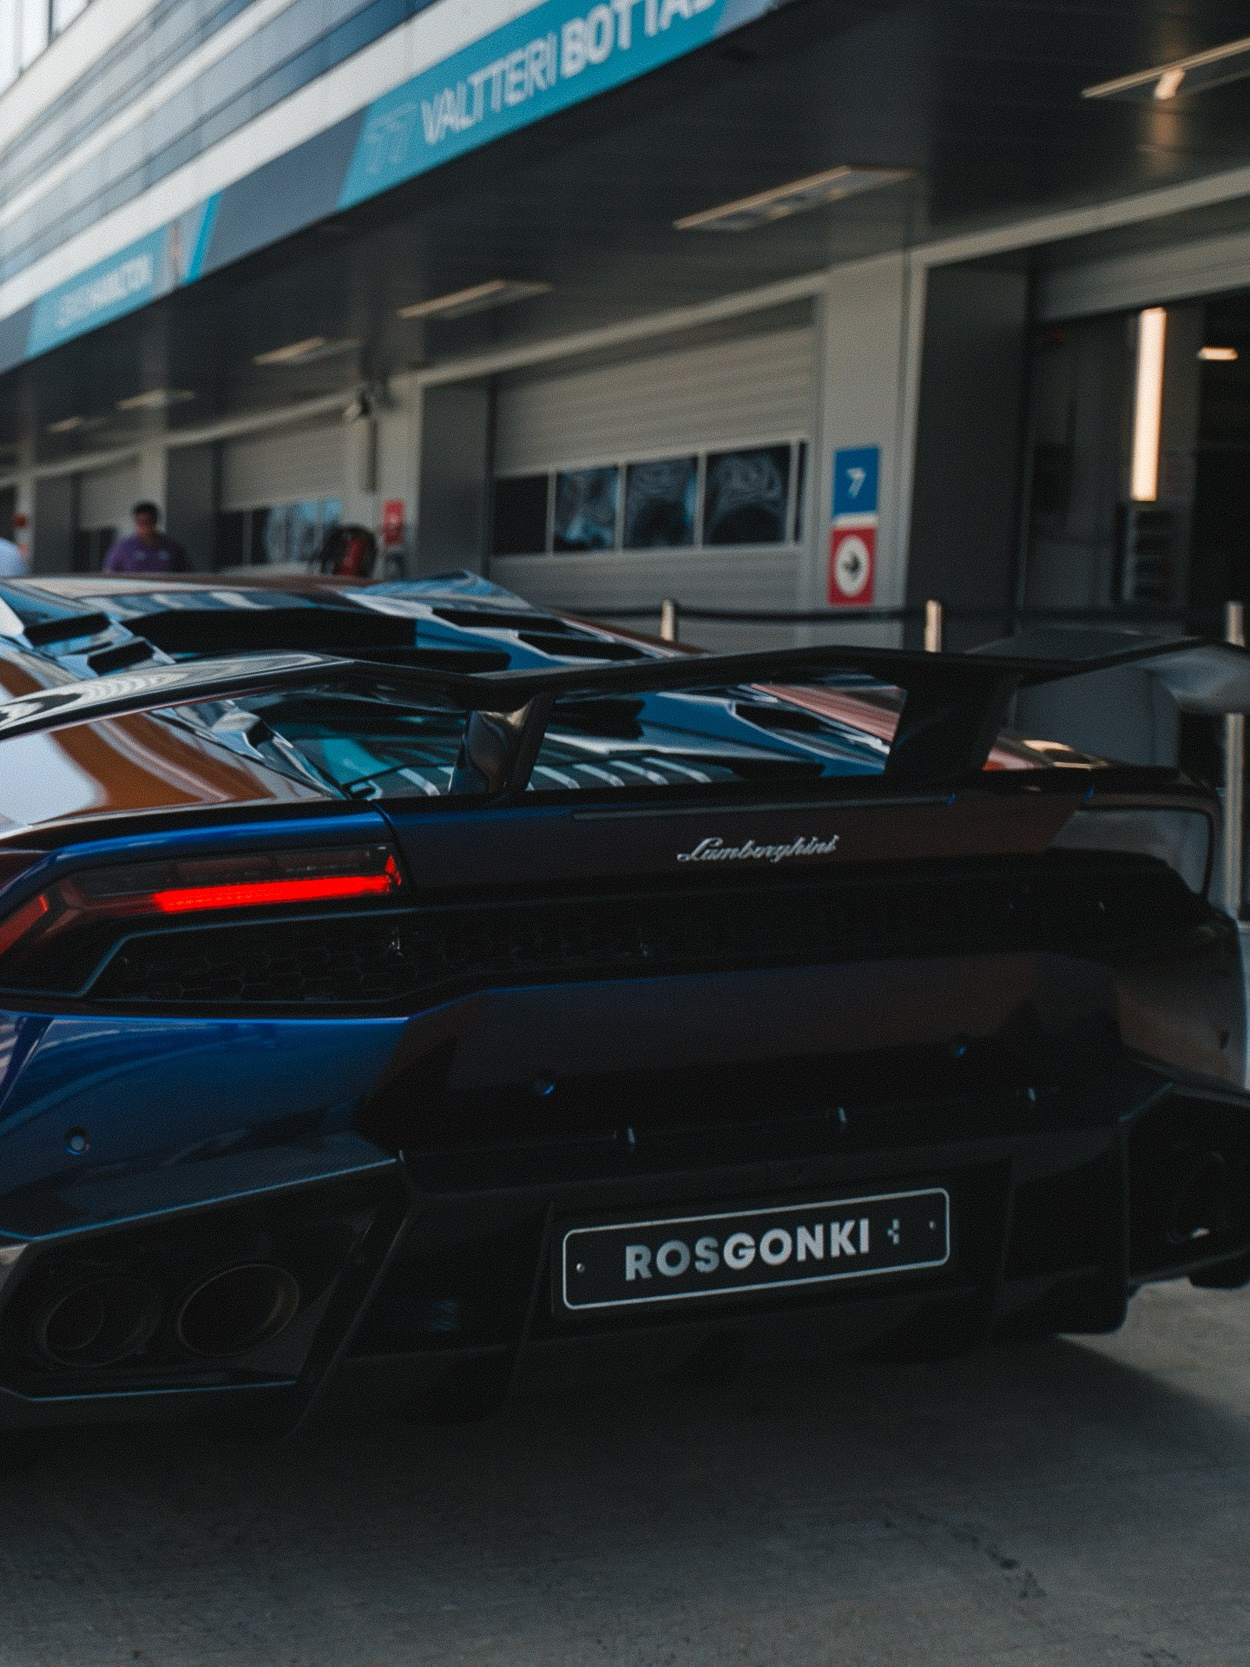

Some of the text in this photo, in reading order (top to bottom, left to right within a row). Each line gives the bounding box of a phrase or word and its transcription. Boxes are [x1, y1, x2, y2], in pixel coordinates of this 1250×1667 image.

[421, 31, 557, 145] VALTTERI
[559, 0, 716, 80] BOTT
[846, 467, 866, 499] 7
[676, 834, 841, 863] Lamborghini
[624, 1217, 869, 1282] ROSGONKI
